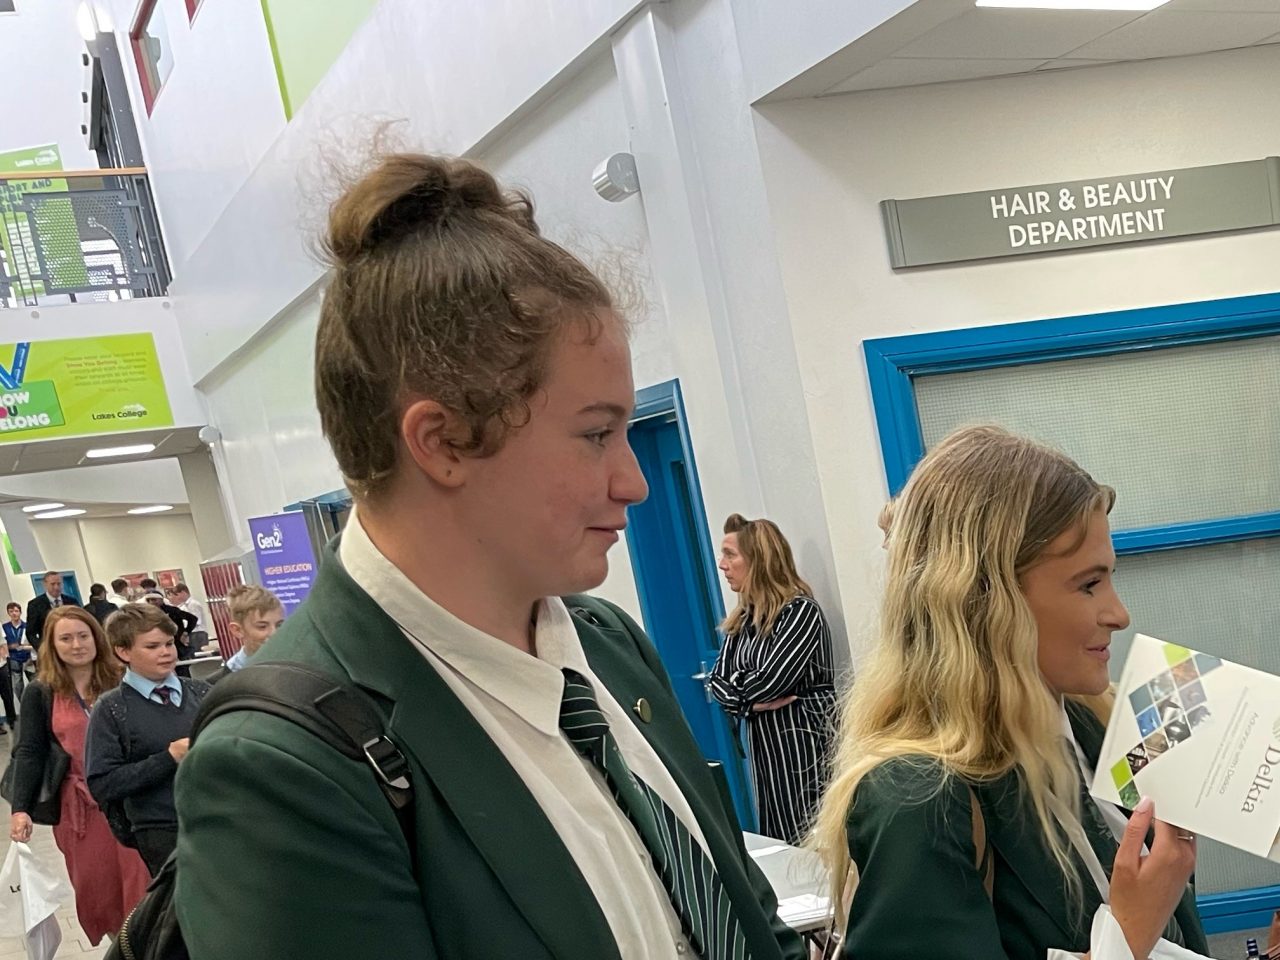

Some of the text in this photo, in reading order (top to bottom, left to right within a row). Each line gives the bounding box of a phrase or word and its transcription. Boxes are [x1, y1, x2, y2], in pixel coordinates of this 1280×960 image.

[990, 176, 1176, 219] HAIR & BEAUTY
[1008, 208, 1166, 248] DEPARTMENT
[0, 391, 30, 406] OW
[91, 409, 148, 421] Lakes College
